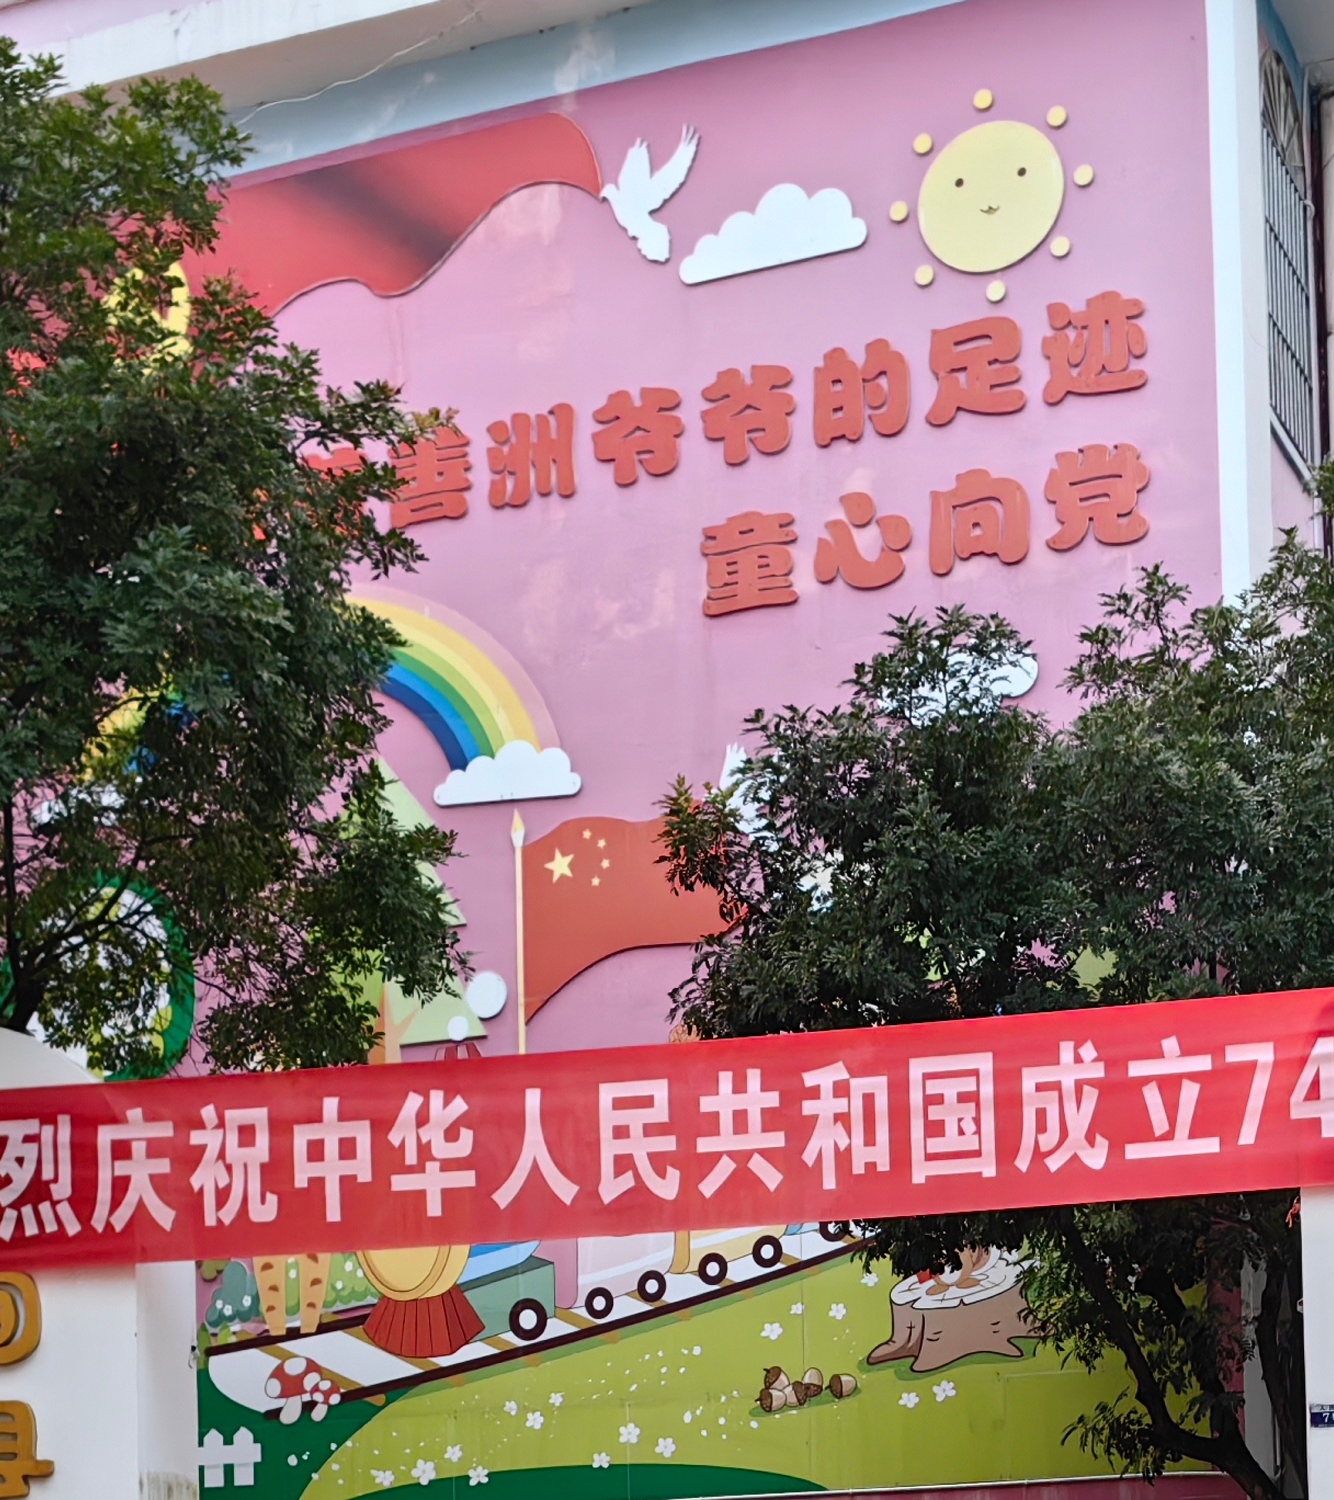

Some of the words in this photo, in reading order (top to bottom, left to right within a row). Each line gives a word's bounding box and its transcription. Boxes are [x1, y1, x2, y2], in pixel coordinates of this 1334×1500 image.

[299, 290, 1148, 540] 善洲爷爷的足迹
[700, 442, 1149, 617] 童心向党
